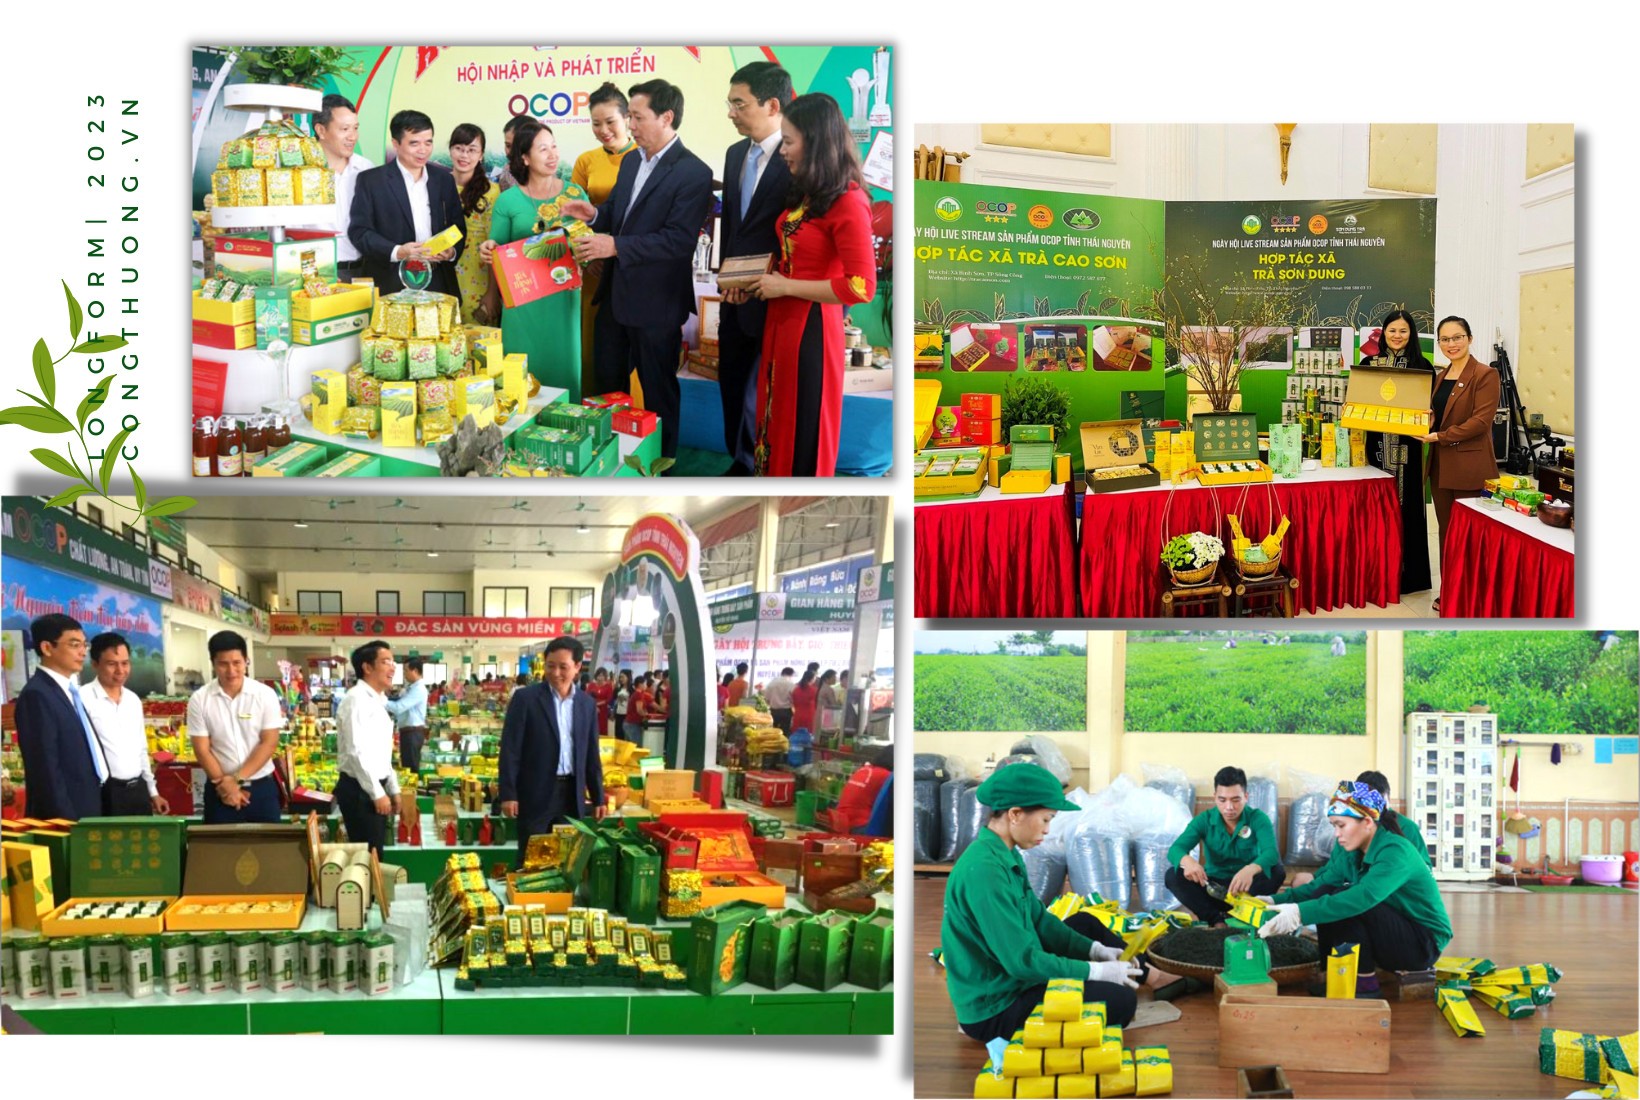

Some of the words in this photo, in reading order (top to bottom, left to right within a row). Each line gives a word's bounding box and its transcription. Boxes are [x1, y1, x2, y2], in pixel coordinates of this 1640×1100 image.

[457, 62, 482, 85] HỘI
[487, 59, 530, 83] NHẬP
[534, 57, 556, 78] VÀ
[561, 54, 603, 77] PHÁT
[607, 47, 656, 74] TRIỂN
[508, 92, 591, 117] OCOP
[976, 200, 1017, 215] OCOP
[924, 226, 939, 240] HỘI
[941, 229, 960, 240] LIVE
[961, 230, 996, 242] STREAM
[997, 230, 1014, 243] SẢN
[1015, 230, 1040, 245] PHẨM
[1041, 235, 1062, 246] OCOP
[1063, 234, 1081, 247] TỈNH
[1082, 236, 1100, 248] THÁI
[1101, 238, 1132, 250] NGUYÊN
[1213, 239, 1229, 248] NGÀY
[1229, 239, 1240, 250] HỘI
[1241, 240, 1254, 249] LIVE
[1254, 239, 1279, 249] STREAM
[1280, 237, 1293, 249] SẢN
[1293, 236, 1312, 248] PHẨM
[1312, 239, 1329, 248] OCOP
[1330, 237, 1344, 248] TỈNH
[1345, 238, 1360, 248] THÁI
[1360, 236, 1386, 248] NGUYÊN
[947, 245, 983, 263] TÁC
[989, 248, 1014, 264] XÃ
[1018, 249, 1049, 266] TRÀ
[1053, 253, 1090, 268] CAO
[1094, 255, 1128, 270] SƠN
[1259, 252, 1286, 268] HỢP
[1289, 251, 1315, 265] TÁC
[1318, 251, 1336, 264] XÃ
[1253, 266, 1276, 280] TRÀ
[1279, 268, 1306, 280] SƠN
[1309, 268, 1346, 280] DUNG
[14, 507, 68, 554] OCOP
[69, 536, 87, 565] CHẤT
[110, 556, 120, 576] AN
[151, 565, 171, 588] OCOP
[790, 577, 808, 590] Bánh
[809, 574, 828, 587] Răng
[790, 598, 814, 609] GIAN
[816, 597, 842, 609] HÀNG
[761, 609, 783, 617] OCOP
[395, 619, 428, 635] ĐẶC
[432, 619, 463, 633] SẢN
[468, 619, 513, 633] VÙNG
[517, 619, 555, 634] MIỀN
[733, 638, 750, 652] HỘI
